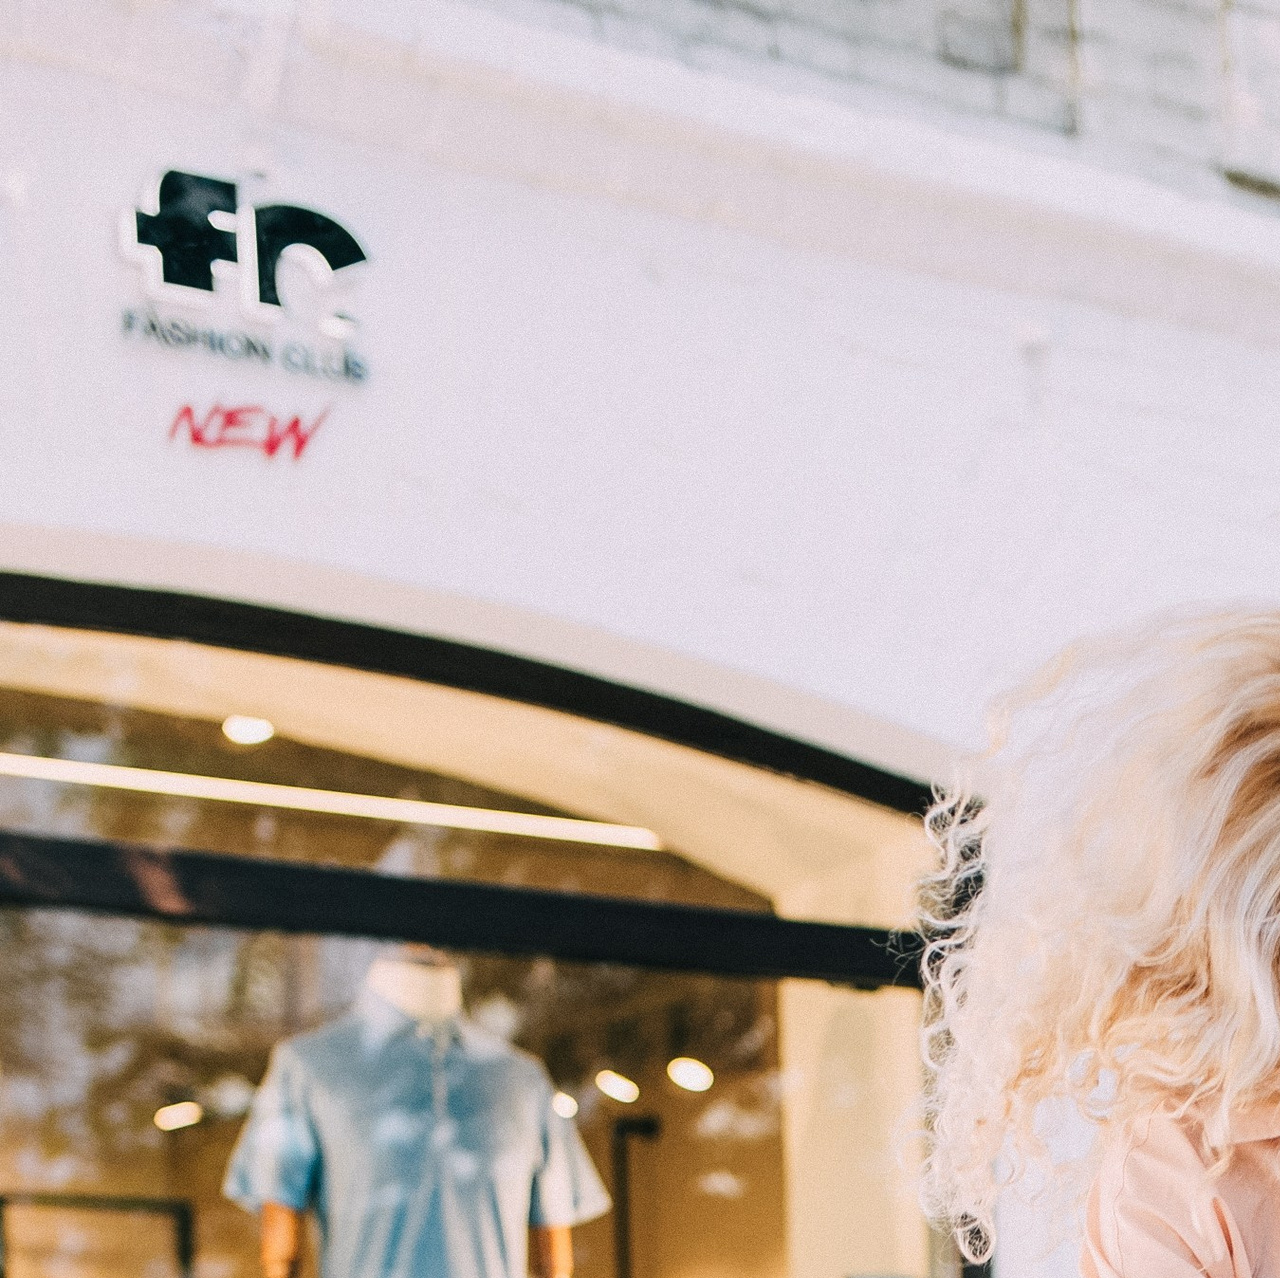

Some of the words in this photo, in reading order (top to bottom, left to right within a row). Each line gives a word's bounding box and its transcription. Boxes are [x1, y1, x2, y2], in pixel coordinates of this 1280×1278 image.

[120, 307, 272, 363] FASHION
[279, 341, 369, 384] CLUB
[167, 400, 332, 461] NEW
